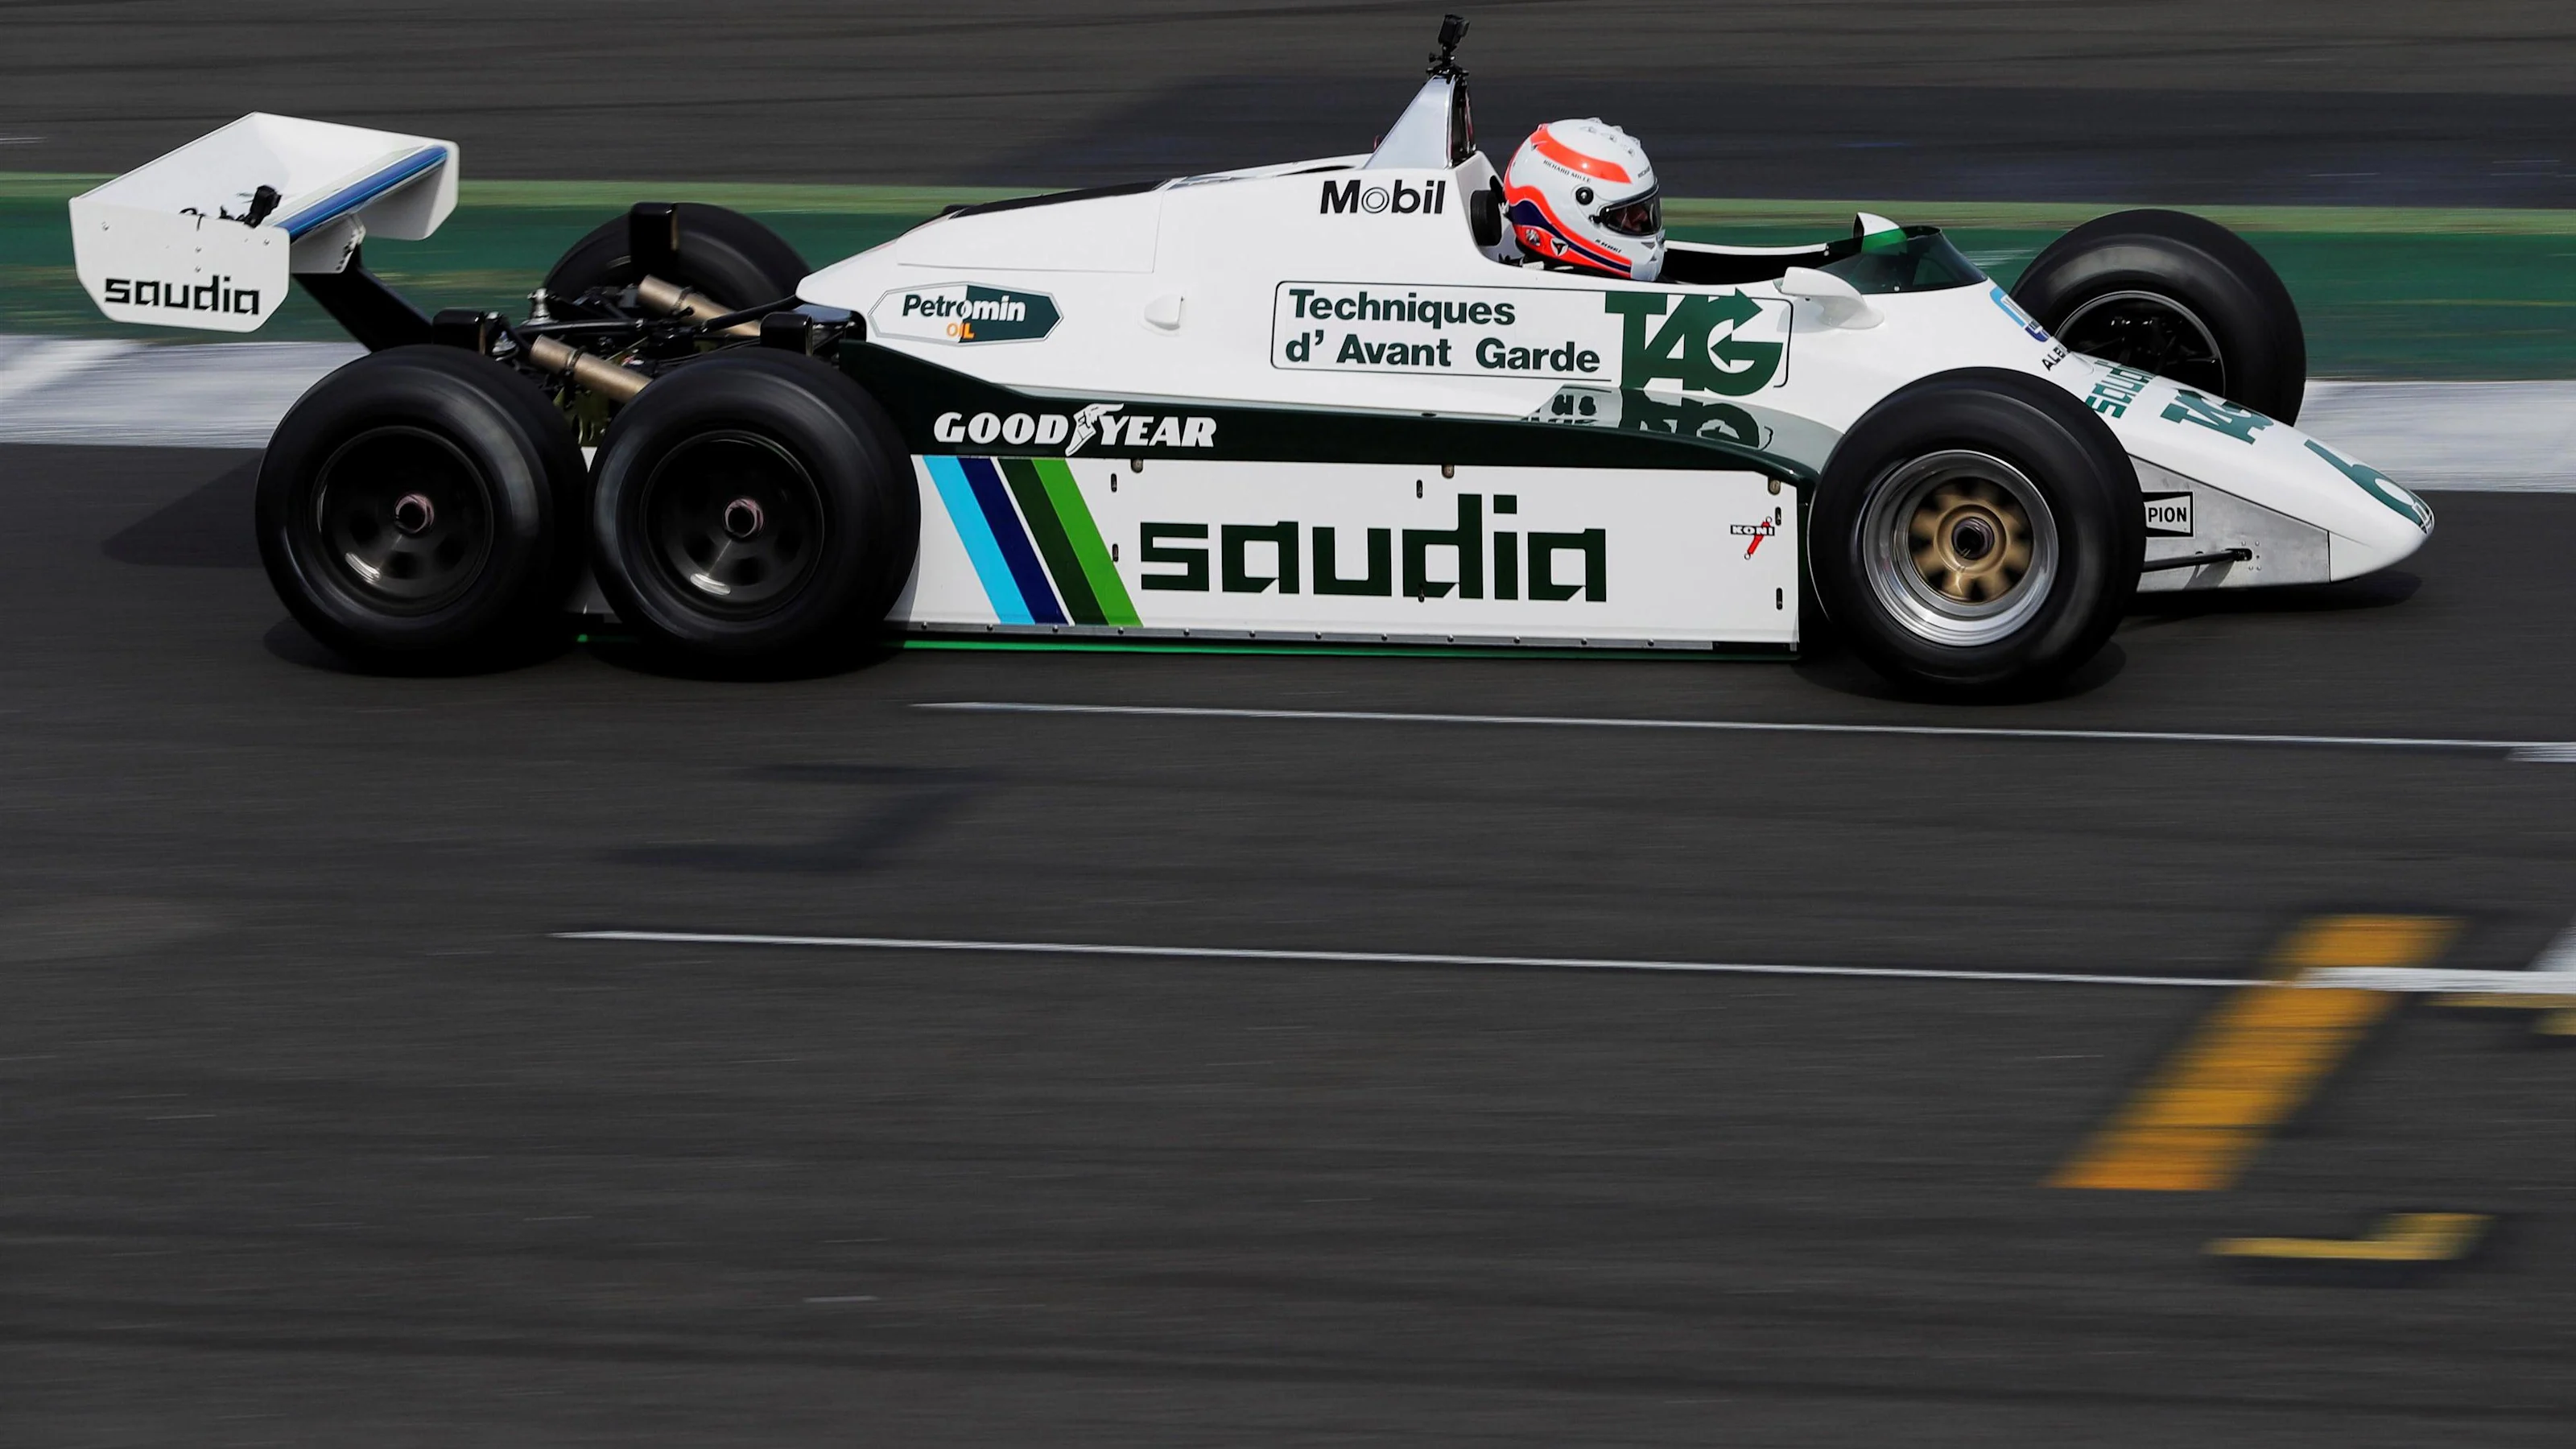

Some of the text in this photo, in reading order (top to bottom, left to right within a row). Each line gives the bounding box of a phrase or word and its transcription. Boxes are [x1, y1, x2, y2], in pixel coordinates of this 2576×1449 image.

[1319, 179, 1447, 216] Mobil
[104, 275, 260, 316] saudia
[902, 294, 1026, 322] Petromin
[1289, 288, 1515, 329] Techniques
[947, 322, 976, 339] OIL
[1604, 287, 1783, 396] TAG
[1335, 332, 1452, 367] Avant
[1476, 336, 1600, 373] Garde
[2042, 344, 2067, 371] ALB
[1732, 525, 1773, 535] KONI
[2148, 506, 2187, 523] PION
[1140, 493, 1607, 603] saudia
